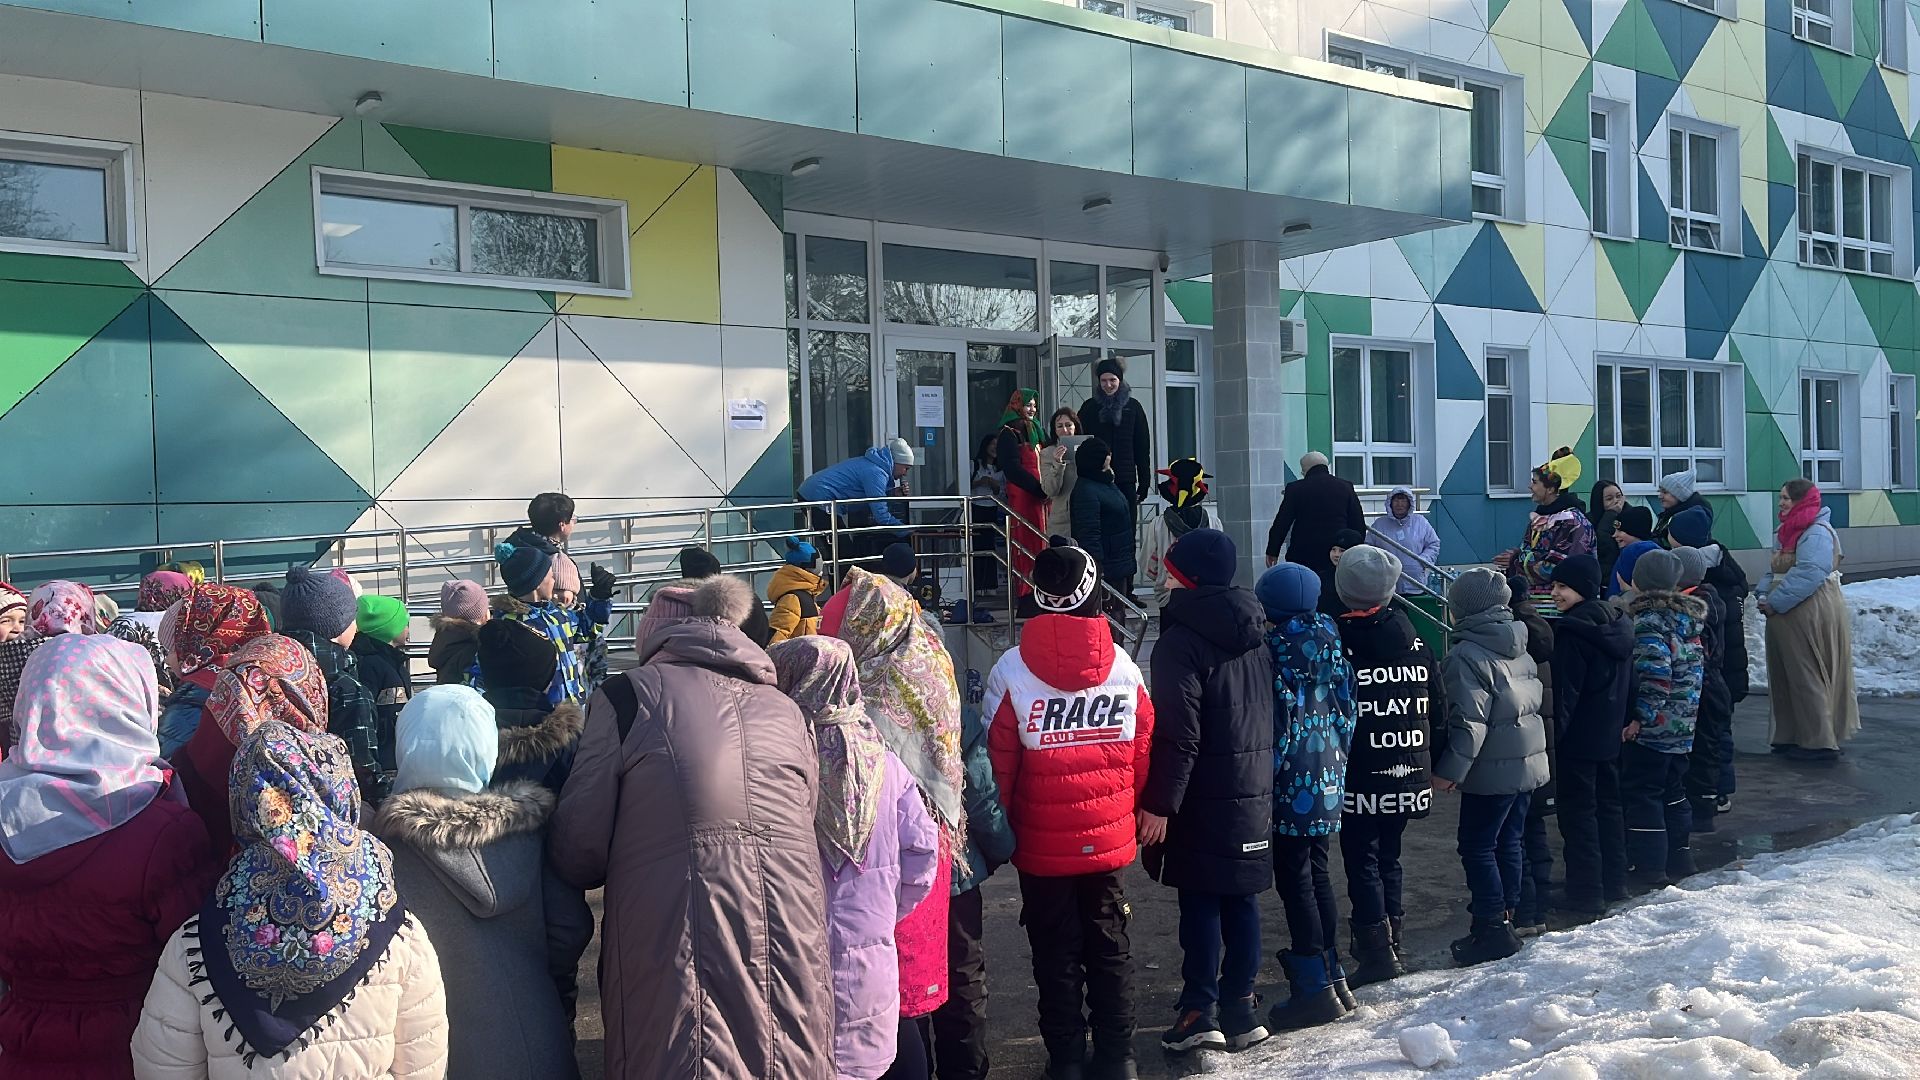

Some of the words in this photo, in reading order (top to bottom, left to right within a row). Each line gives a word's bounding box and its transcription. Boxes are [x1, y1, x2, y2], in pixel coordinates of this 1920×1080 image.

[1357, 665, 1429, 686] SOUND
[1027, 699, 1046, 733] PTD
[1042, 694, 1129, 731] RACE
[1357, 698, 1411, 717] PLAY
[1416, 697, 1429, 714] IT
[1043, 733, 1075, 743] CLUB
[1369, 730, 1424, 749] LOUD
[1343, 787, 1433, 815] ENERG
